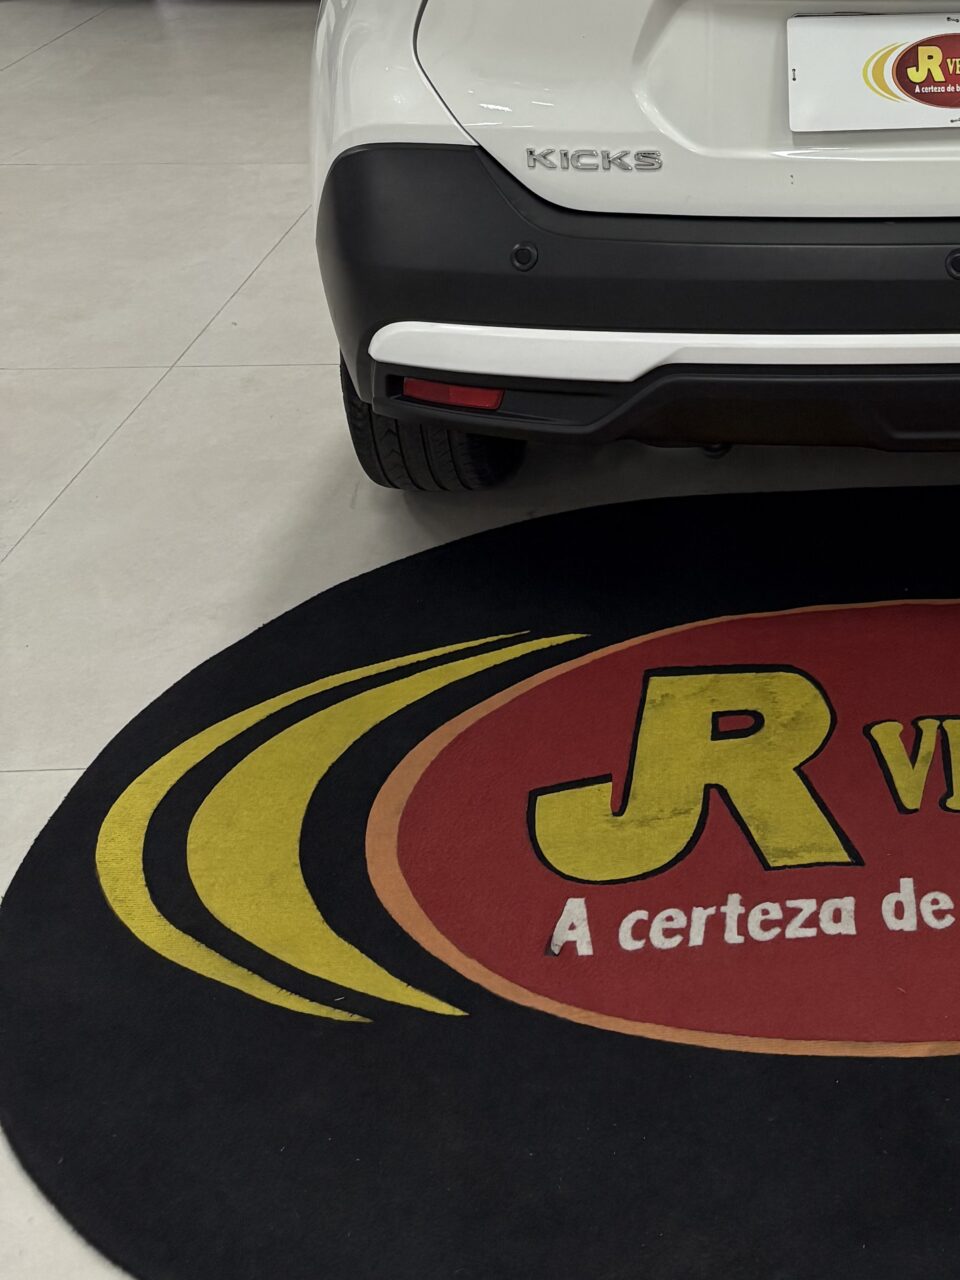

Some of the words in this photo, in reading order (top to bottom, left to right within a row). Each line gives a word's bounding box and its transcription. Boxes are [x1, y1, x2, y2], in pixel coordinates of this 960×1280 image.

[906, 45, 946, 83] JR
[914, 84, 920, 93] A
[921, 84, 945, 93] certeza
[946, 84, 955, 92] de
[526, 147, 663, 170] KICKS
[527, 664, 865, 885] JR
[544, 897, 594, 956] A
[618, 893, 857, 952] certeza
[881, 877, 956, 931] de
